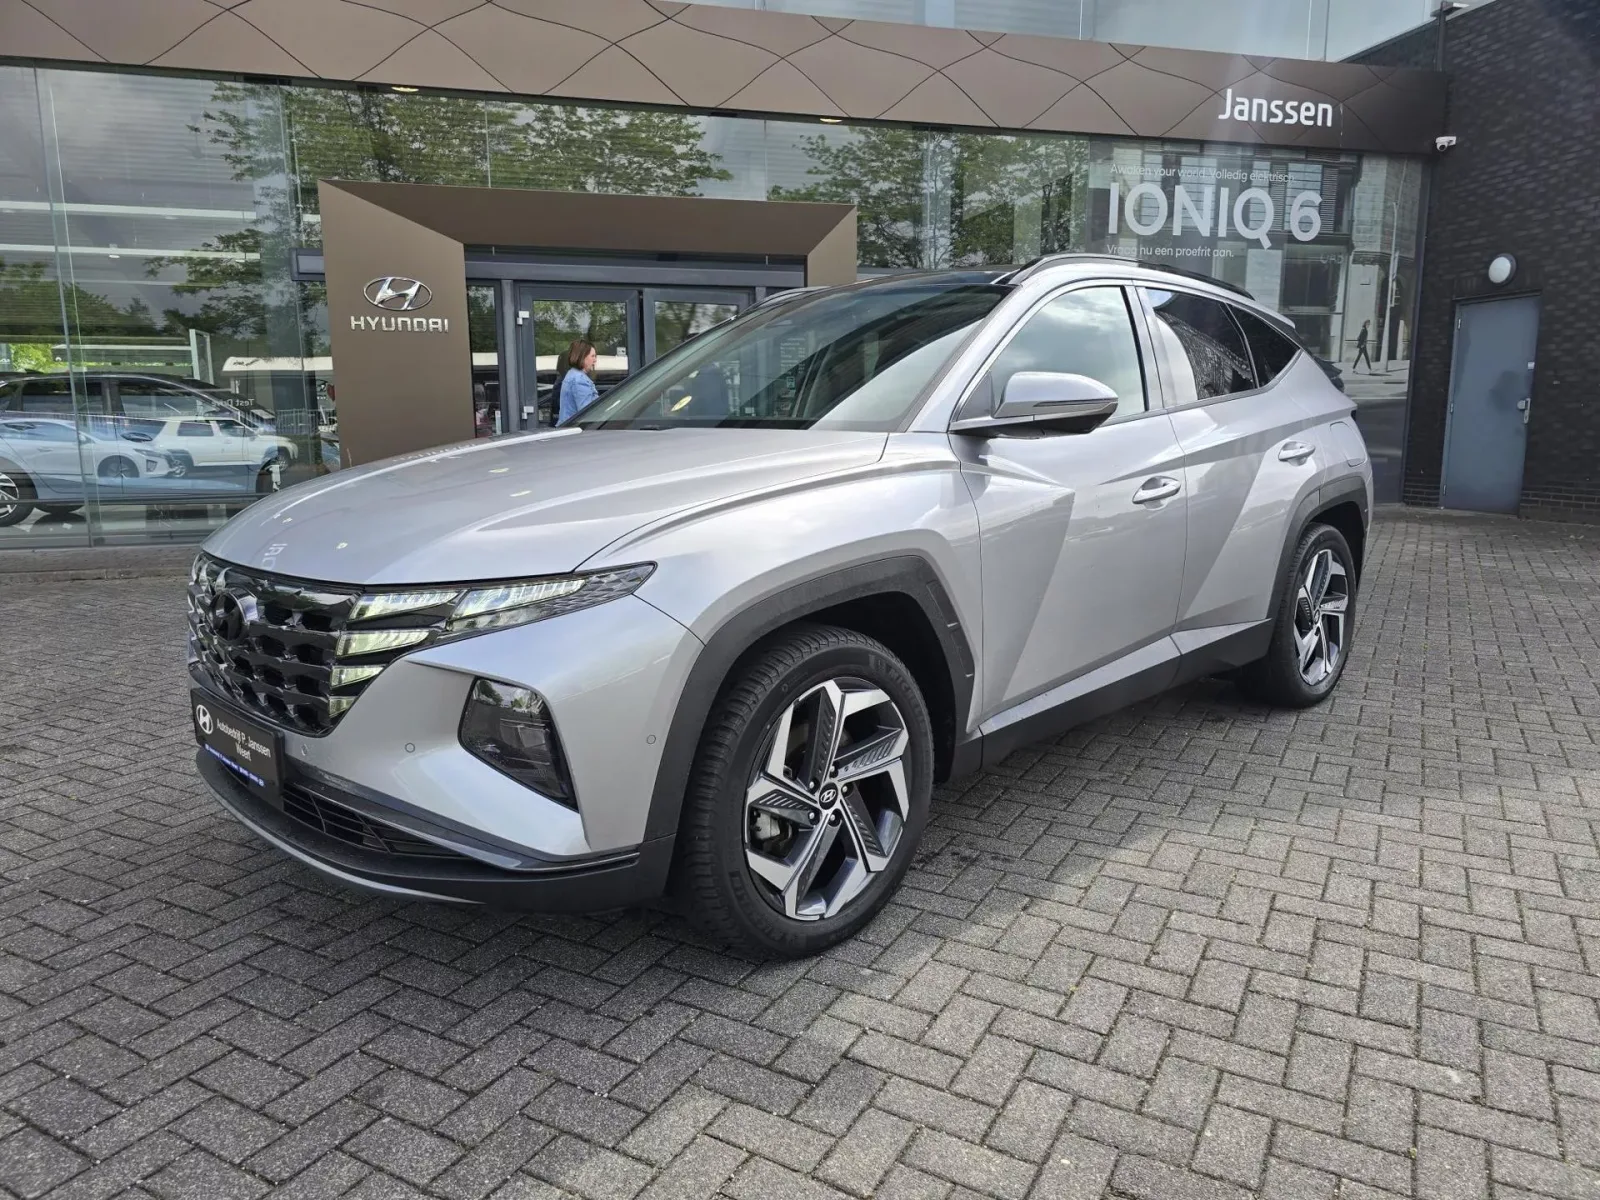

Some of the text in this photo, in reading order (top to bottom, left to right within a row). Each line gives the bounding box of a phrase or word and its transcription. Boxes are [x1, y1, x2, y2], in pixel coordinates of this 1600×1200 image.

[1218, 88, 1333, 127] Janssen
[1153, 167, 1176, 179] your
[1209, 168, 1248, 183] Volledig
[1107, 181, 1323, 250] IONIQ 6
[1139, 245, 1153, 256] nu
[1154, 246, 1174, 257] een
[1175, 245, 1211, 258] proefrit
[1212, 248, 1234, 258] aan.
[350, 315, 449, 333] HYUNDAI
[235, 741, 252, 762] Weert
[247, 735, 272, 759] Janssen
